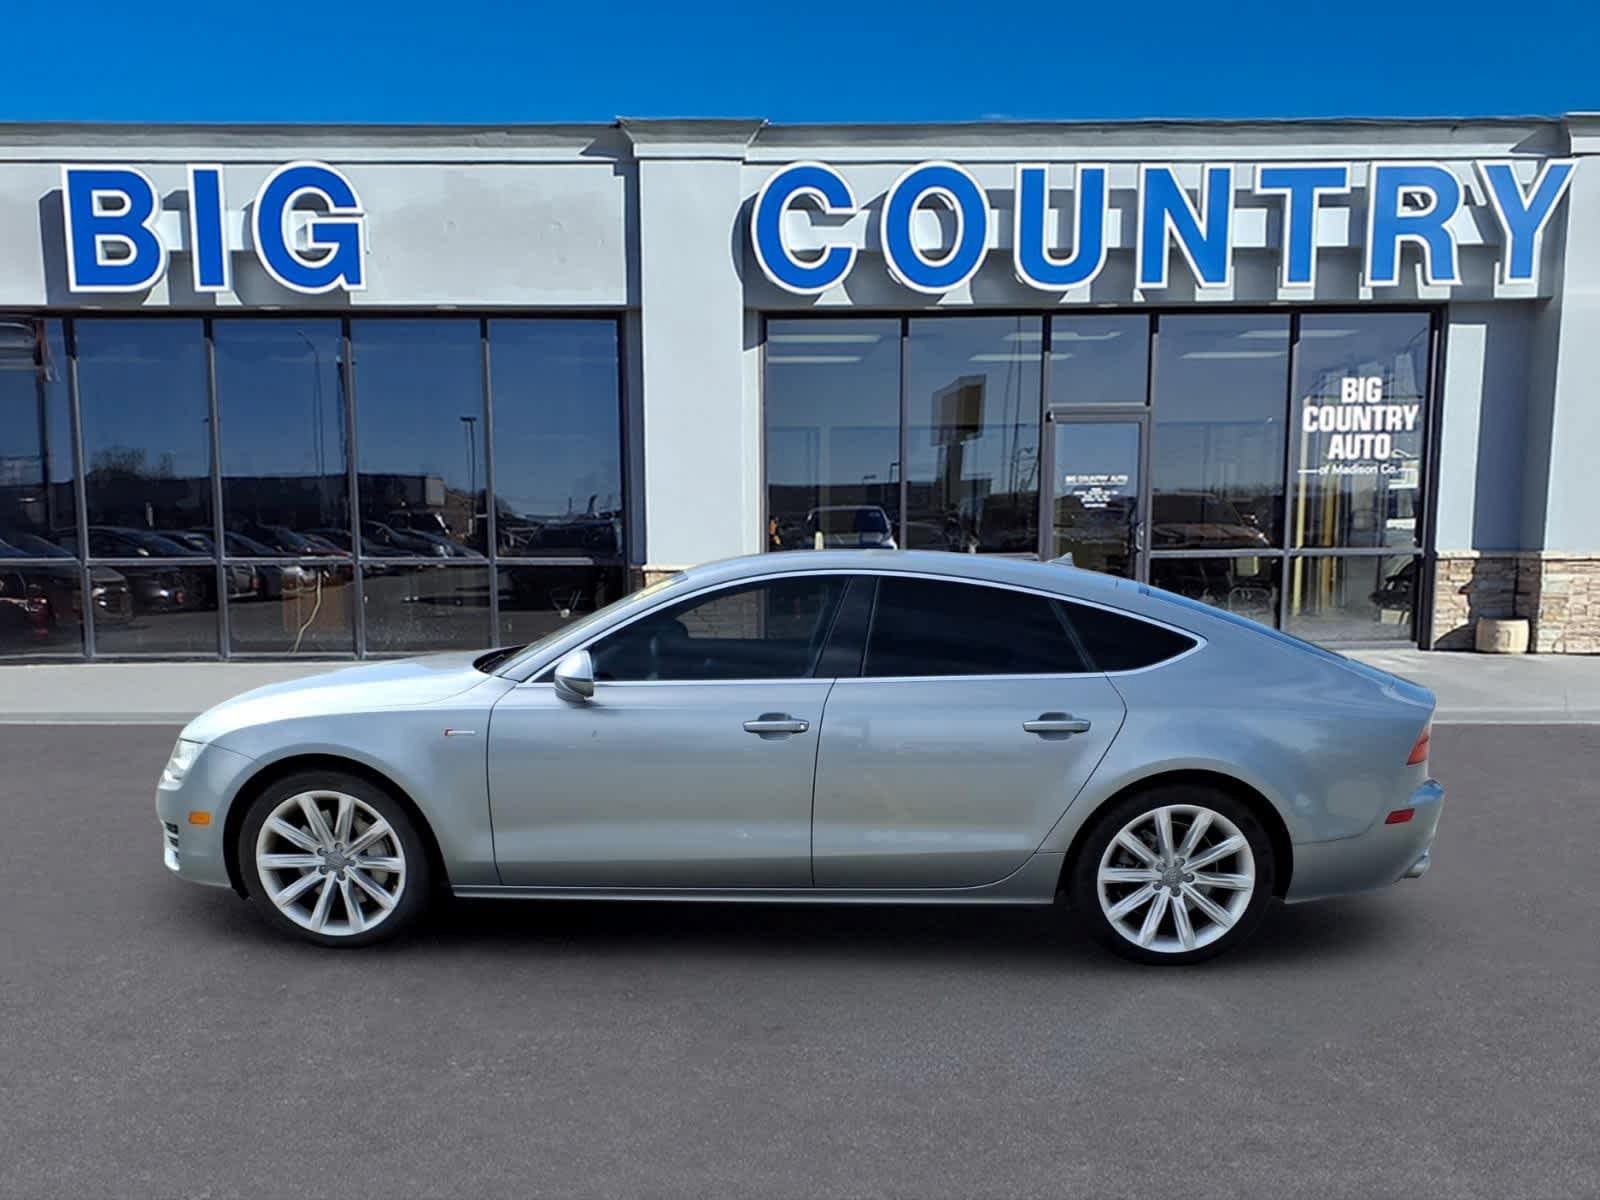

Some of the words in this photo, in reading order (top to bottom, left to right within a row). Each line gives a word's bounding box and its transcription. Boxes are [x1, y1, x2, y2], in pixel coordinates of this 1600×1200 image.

[60, 161, 367, 294] BIG
[750, 158, 1575, 296] COUNTRY
[1341, 376, 1383, 404] BIG
[1302, 404, 1420, 433] COUNTRY
[1327, 433, 1392, 461] AUTO
[1319, 464, 1330, 475] of
[1332, 464, 1378, 474] Madison
